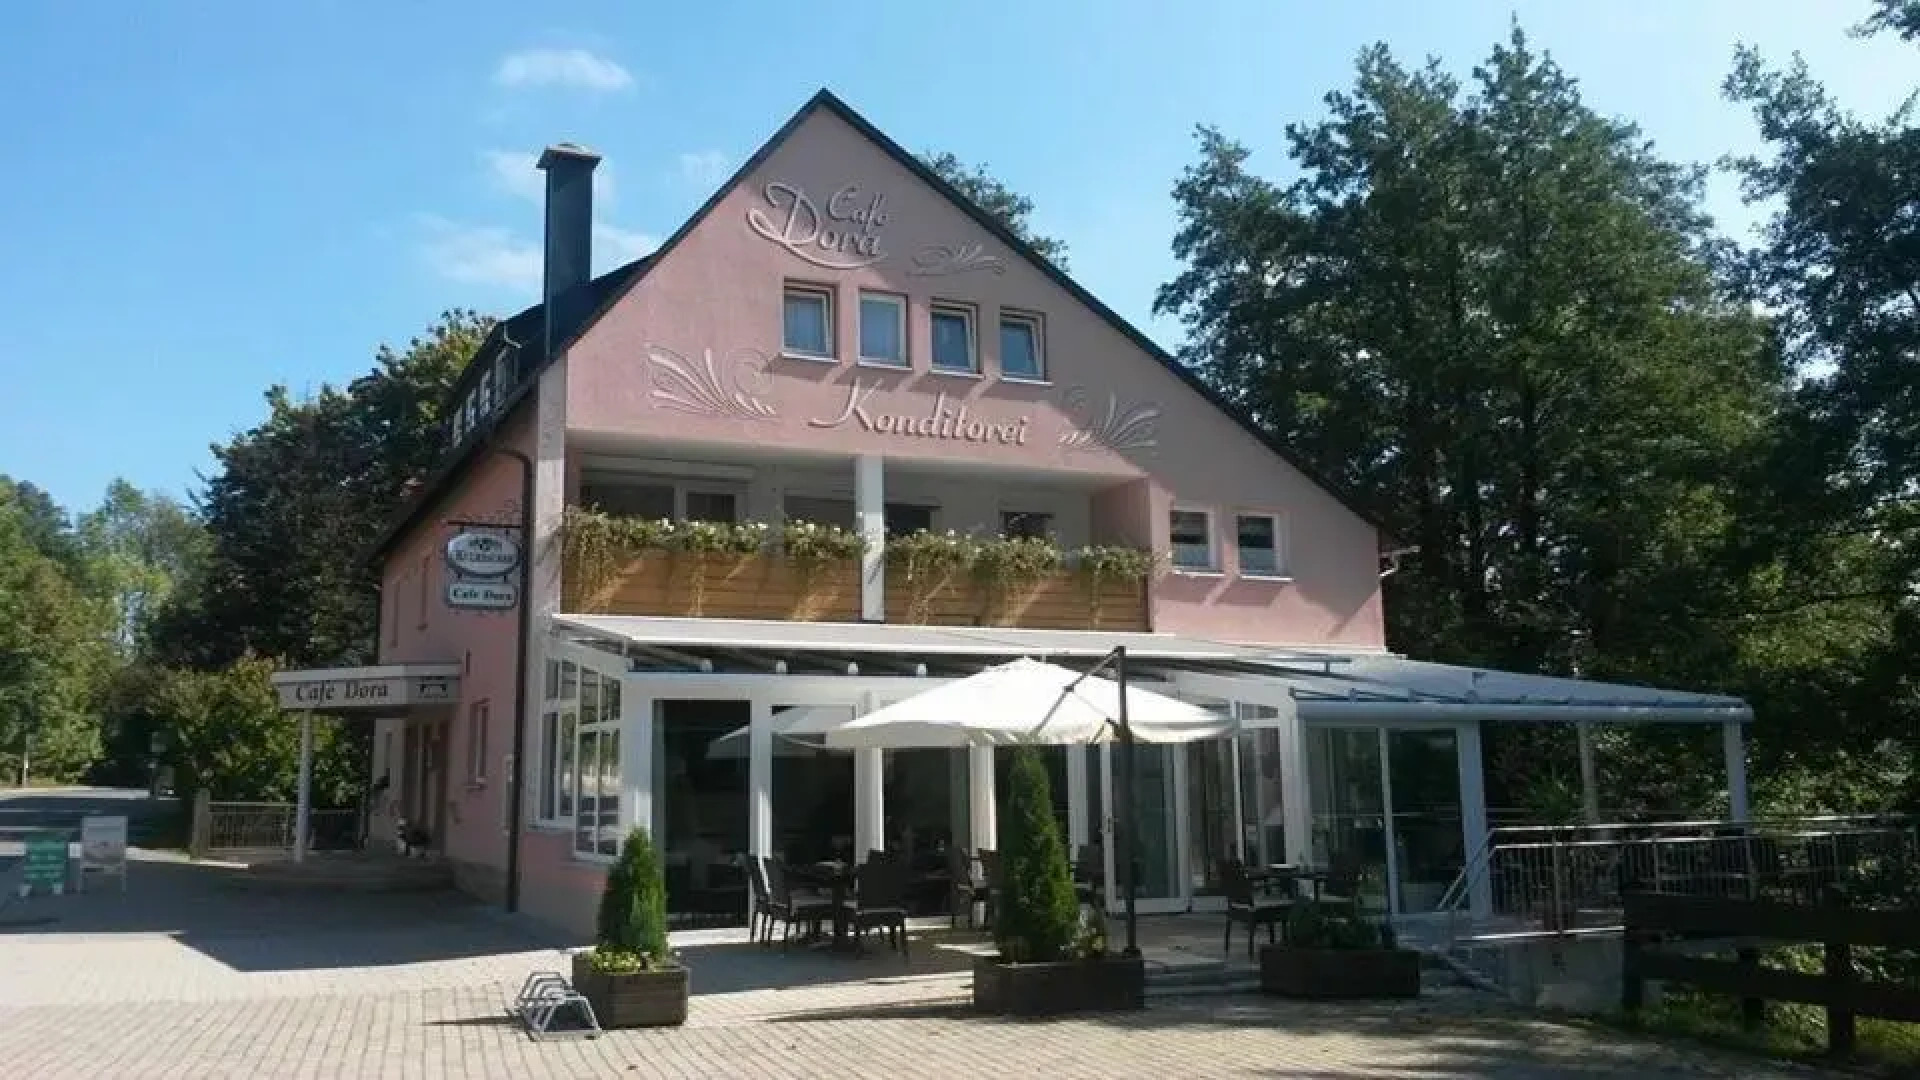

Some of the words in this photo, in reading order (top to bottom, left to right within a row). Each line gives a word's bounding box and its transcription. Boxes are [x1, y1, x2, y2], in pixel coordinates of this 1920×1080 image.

[745, 182, 888, 271] Dora
[807, 376, 1029, 447] Konditorei
[344, 678, 388, 699] Dora
